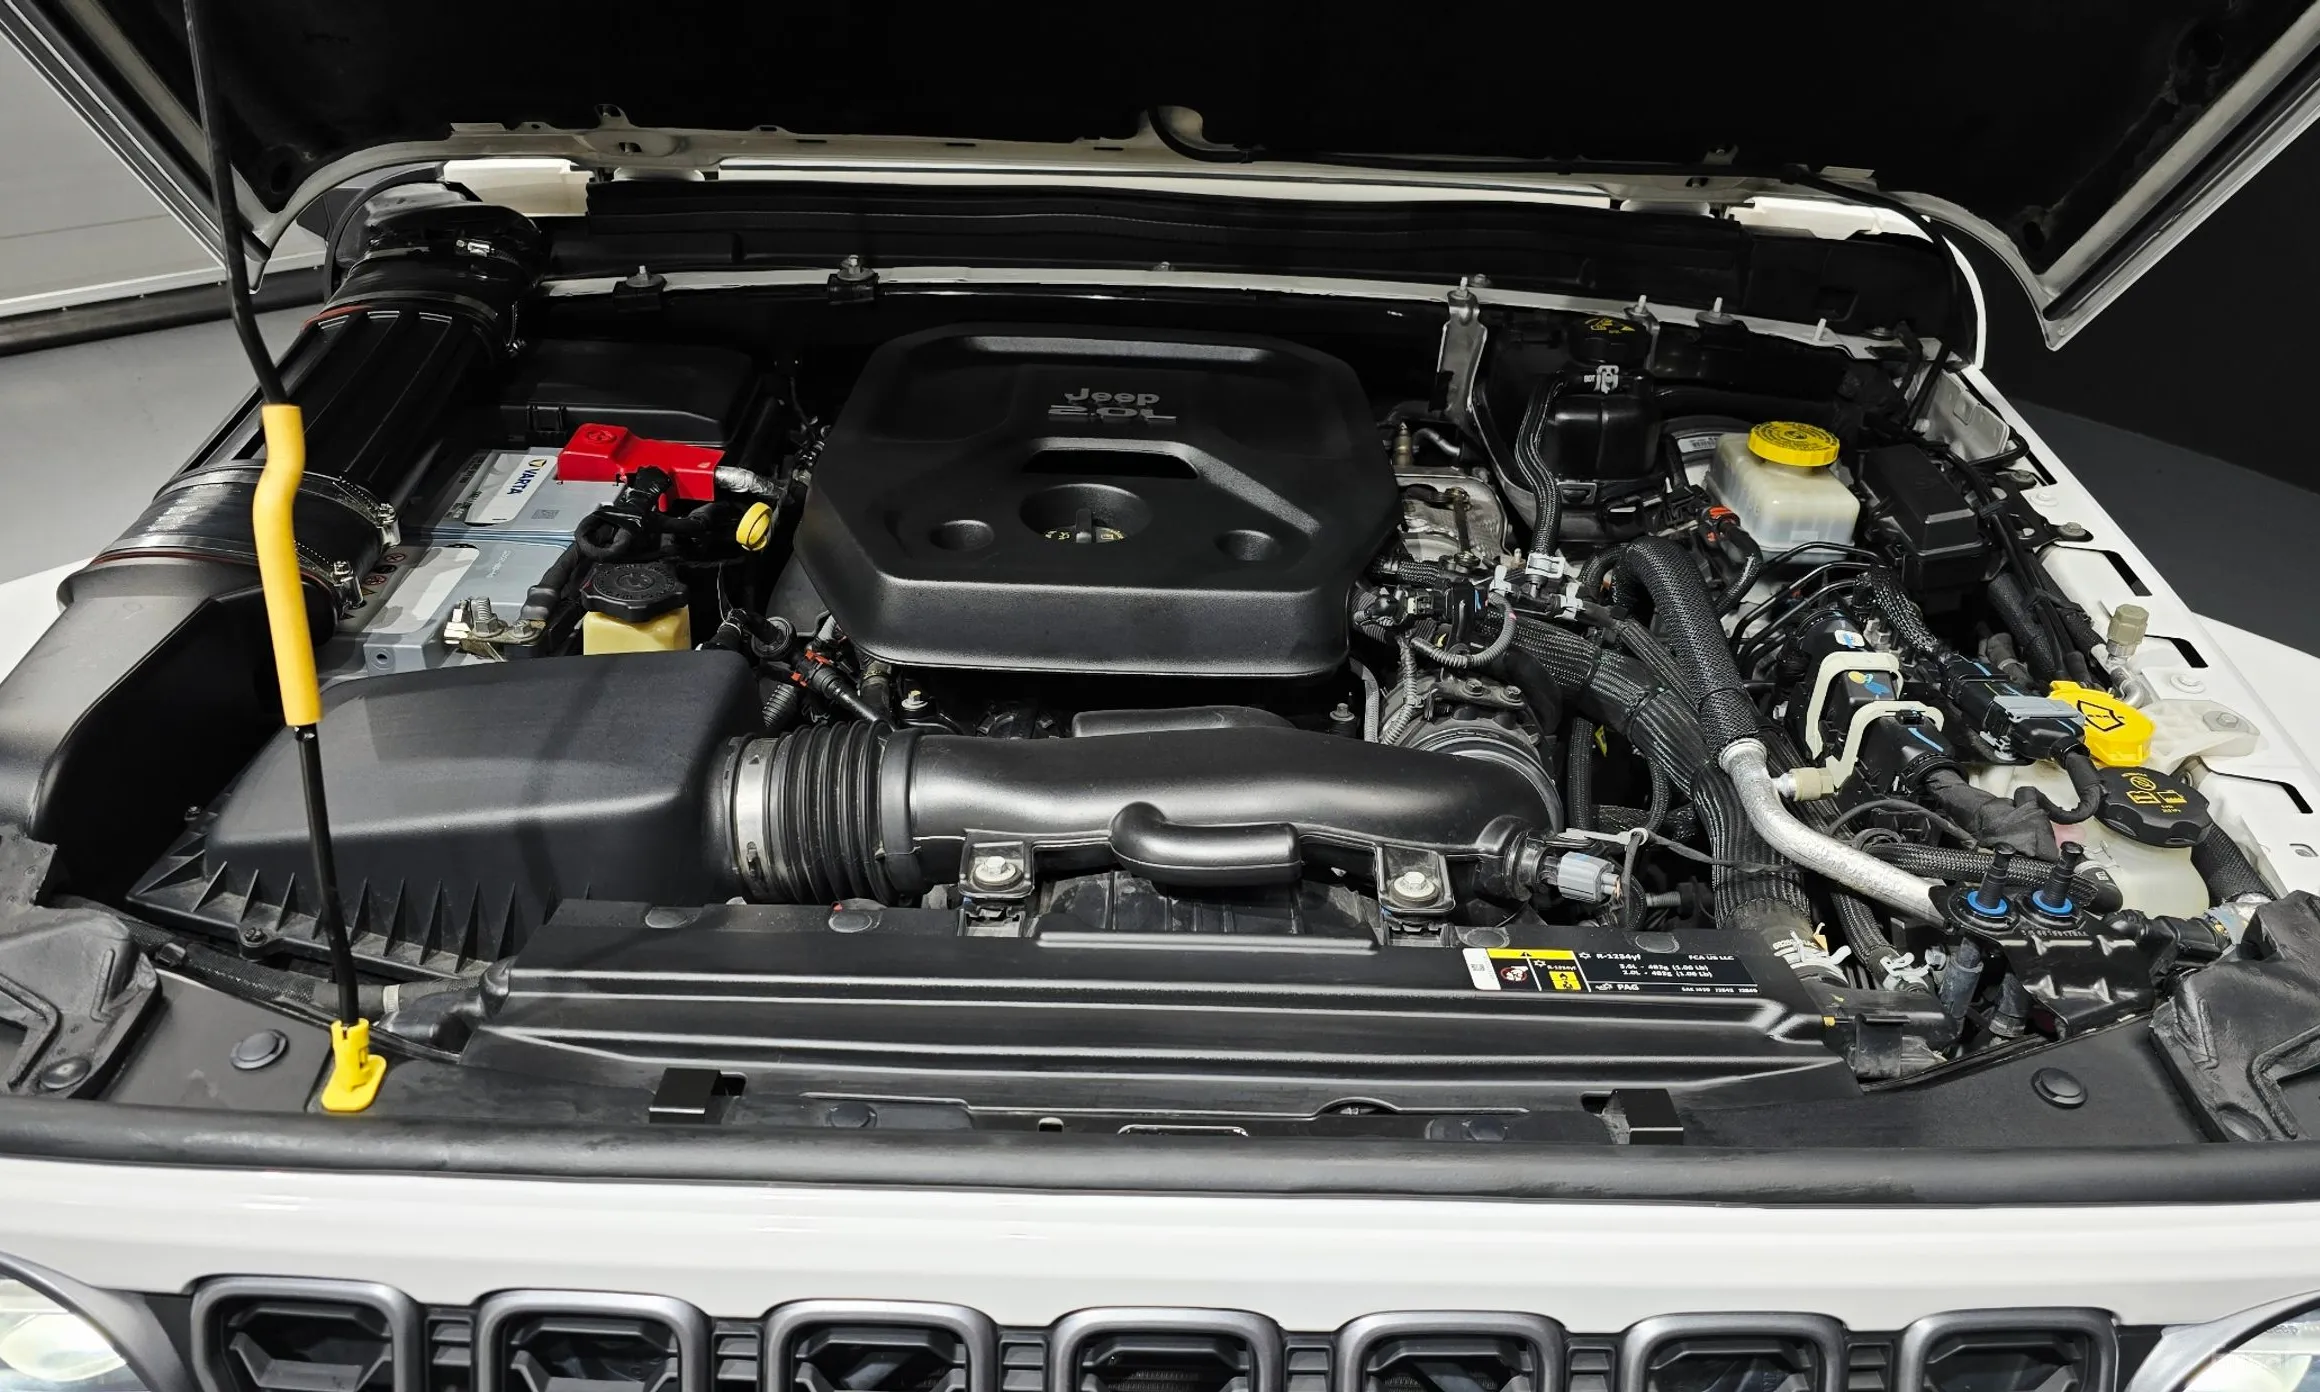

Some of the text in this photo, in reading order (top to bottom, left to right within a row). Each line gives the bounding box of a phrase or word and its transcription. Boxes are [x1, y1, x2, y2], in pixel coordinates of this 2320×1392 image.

[1064, 388, 1160, 406] Jeep
[1048, 405, 1177, 419] 2.0L
[507, 468, 540, 495] VARTA
[1596, 953, 1641, 961] R-1234yf
[1617, 983, 1640, 991] PAG
